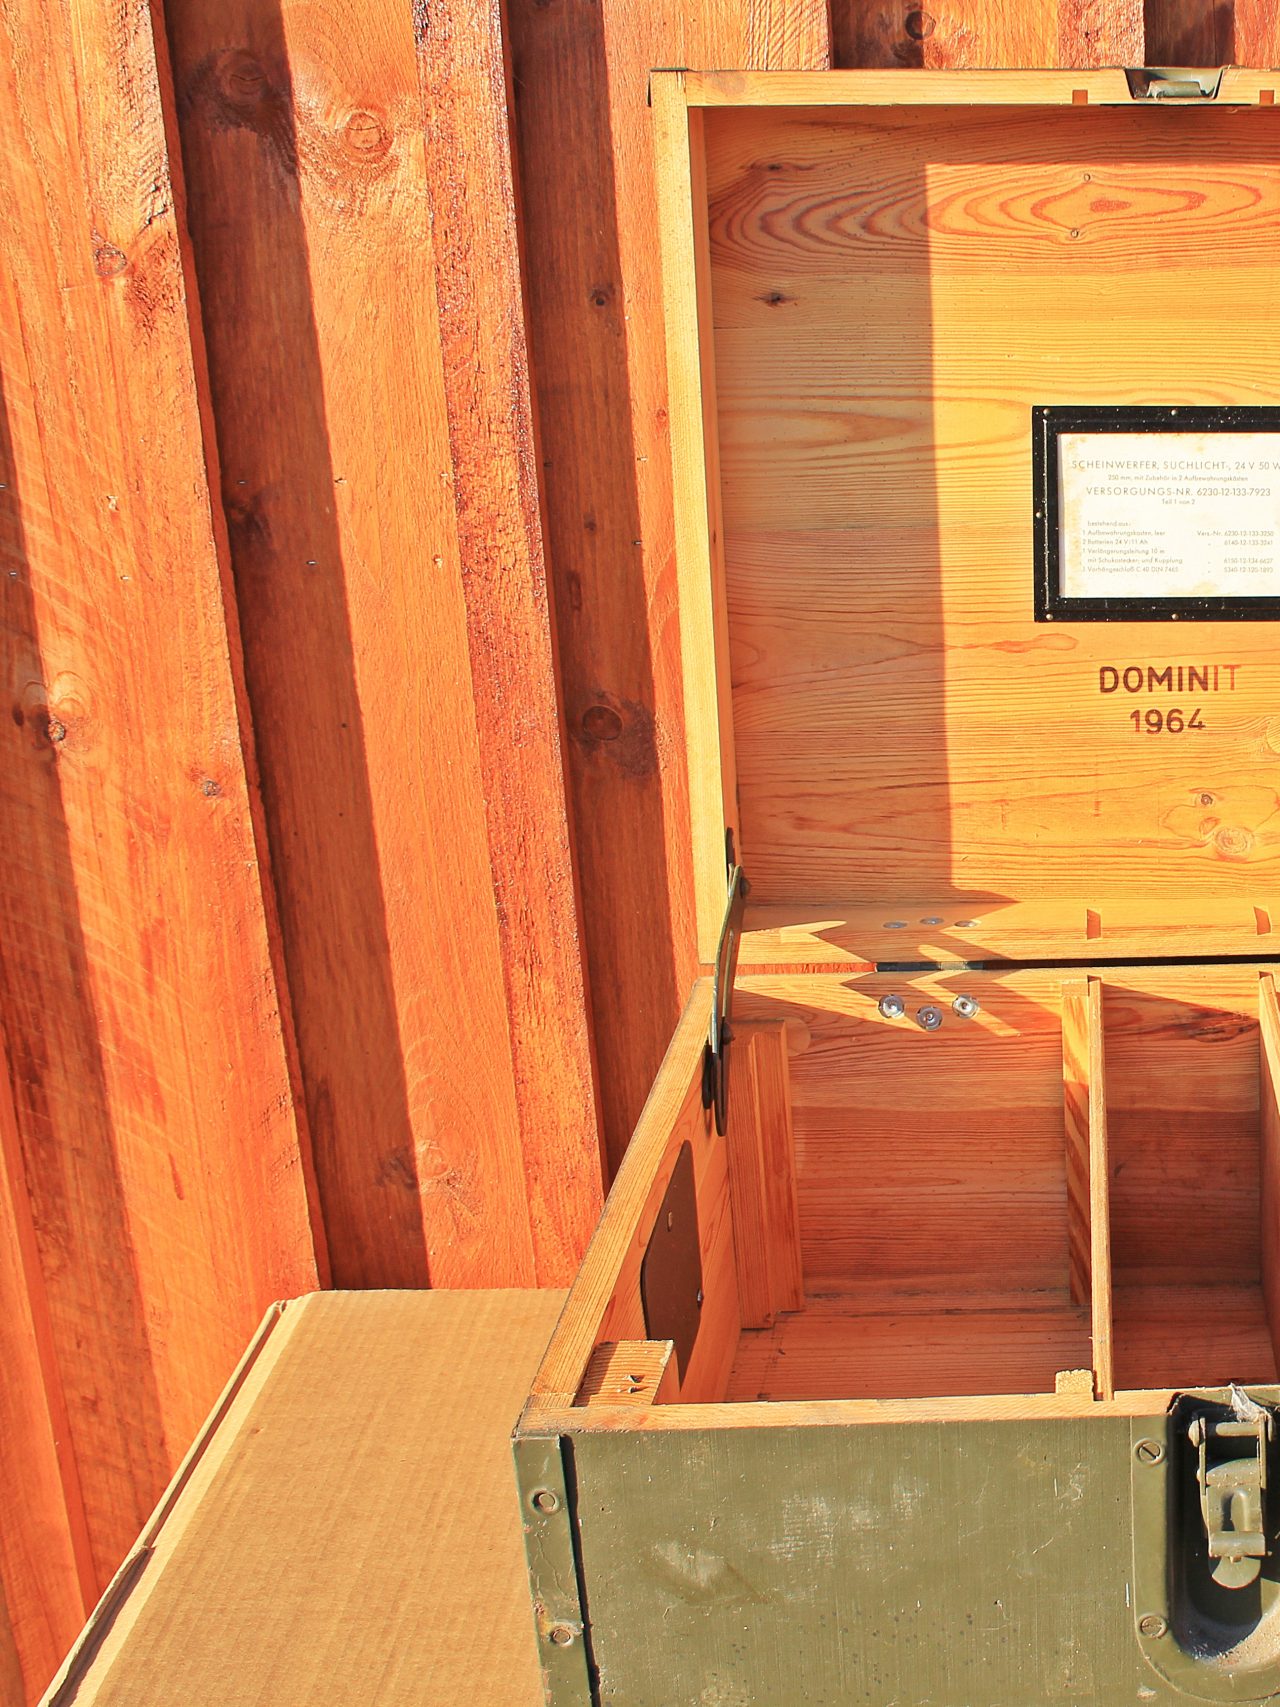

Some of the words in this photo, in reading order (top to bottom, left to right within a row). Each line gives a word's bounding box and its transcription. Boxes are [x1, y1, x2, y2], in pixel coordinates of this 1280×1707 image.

[1072, 460, 1159, 470] SCHEINWERFER,
[1235, 461, 1246, 470] 24
[1248, 461, 1255, 470] V
[1258, 461, 1270, 470] 50
[1086, 486, 1193, 496] VERSORGUNGS-NR.
[1196, 488, 1271, 496] 6230-12-133-7923
[1099, 664, 1242, 693] DOMINIT
[1130, 708, 1206, 734] 1964
